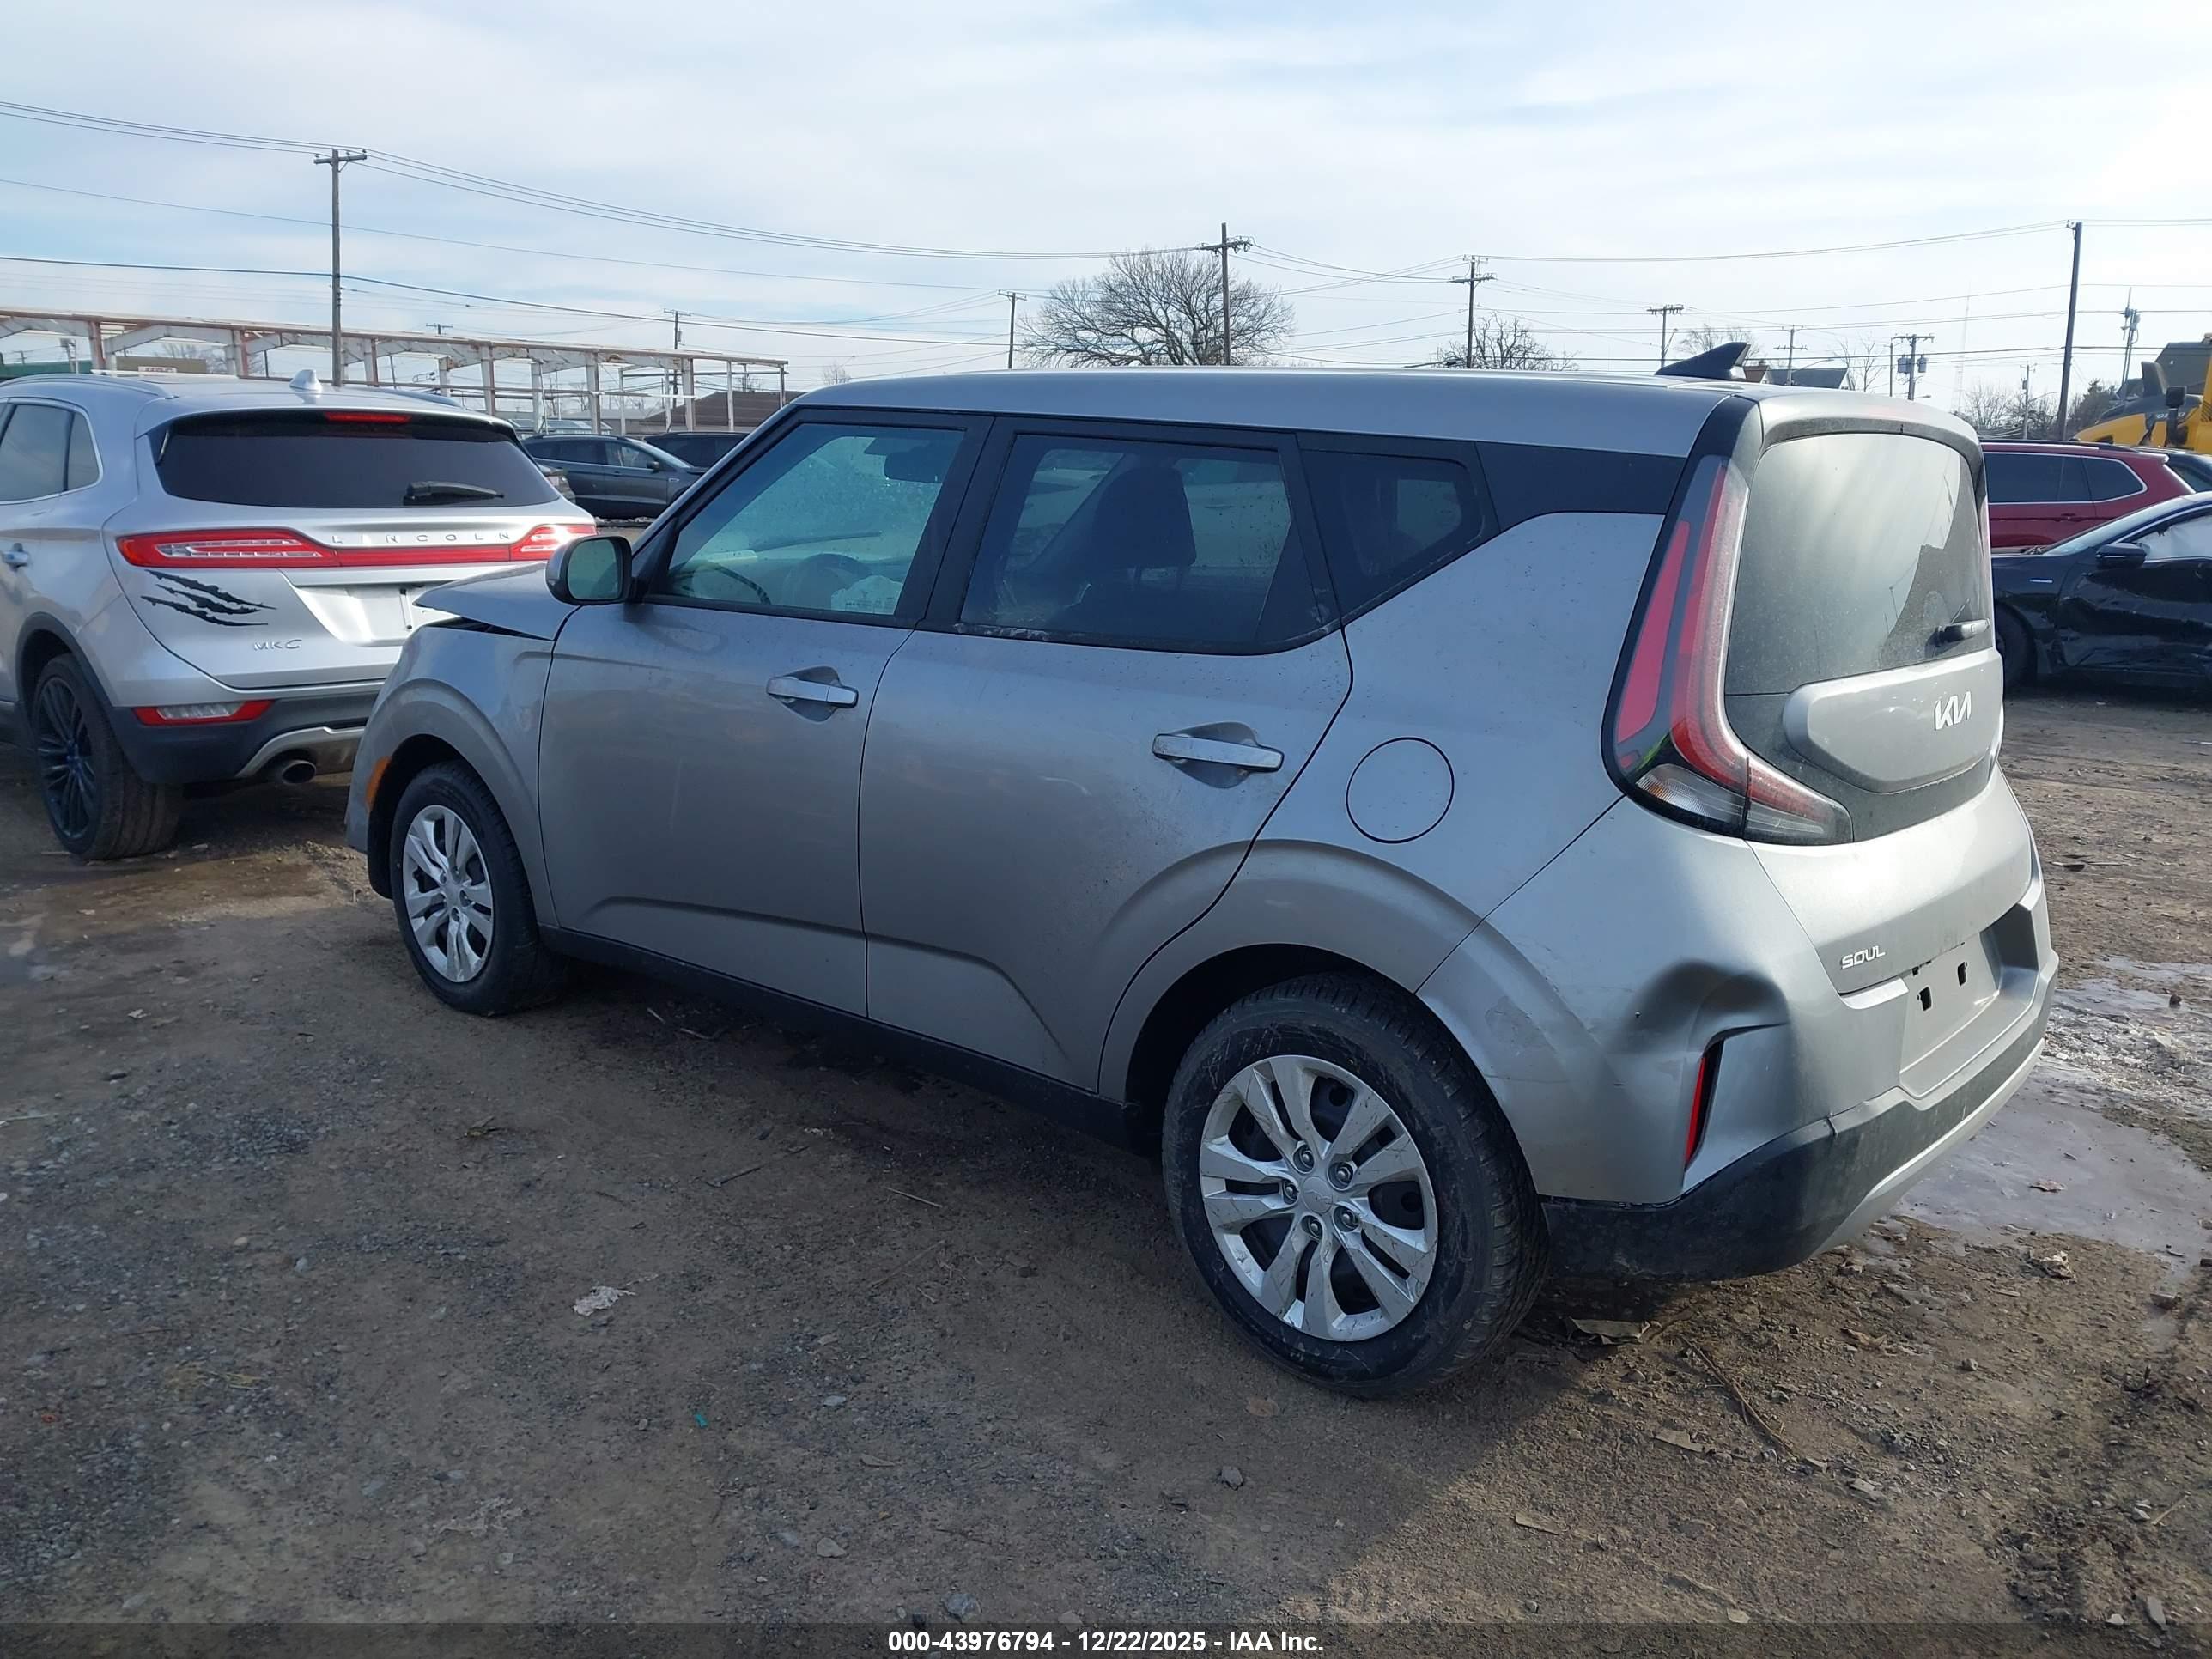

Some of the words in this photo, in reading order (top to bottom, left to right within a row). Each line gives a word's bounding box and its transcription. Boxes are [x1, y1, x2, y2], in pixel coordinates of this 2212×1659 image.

[332, 532, 510, 544] LINCOLN
[253, 638, 302, 651] MKC
[1840, 945, 1886, 969] SOUL
